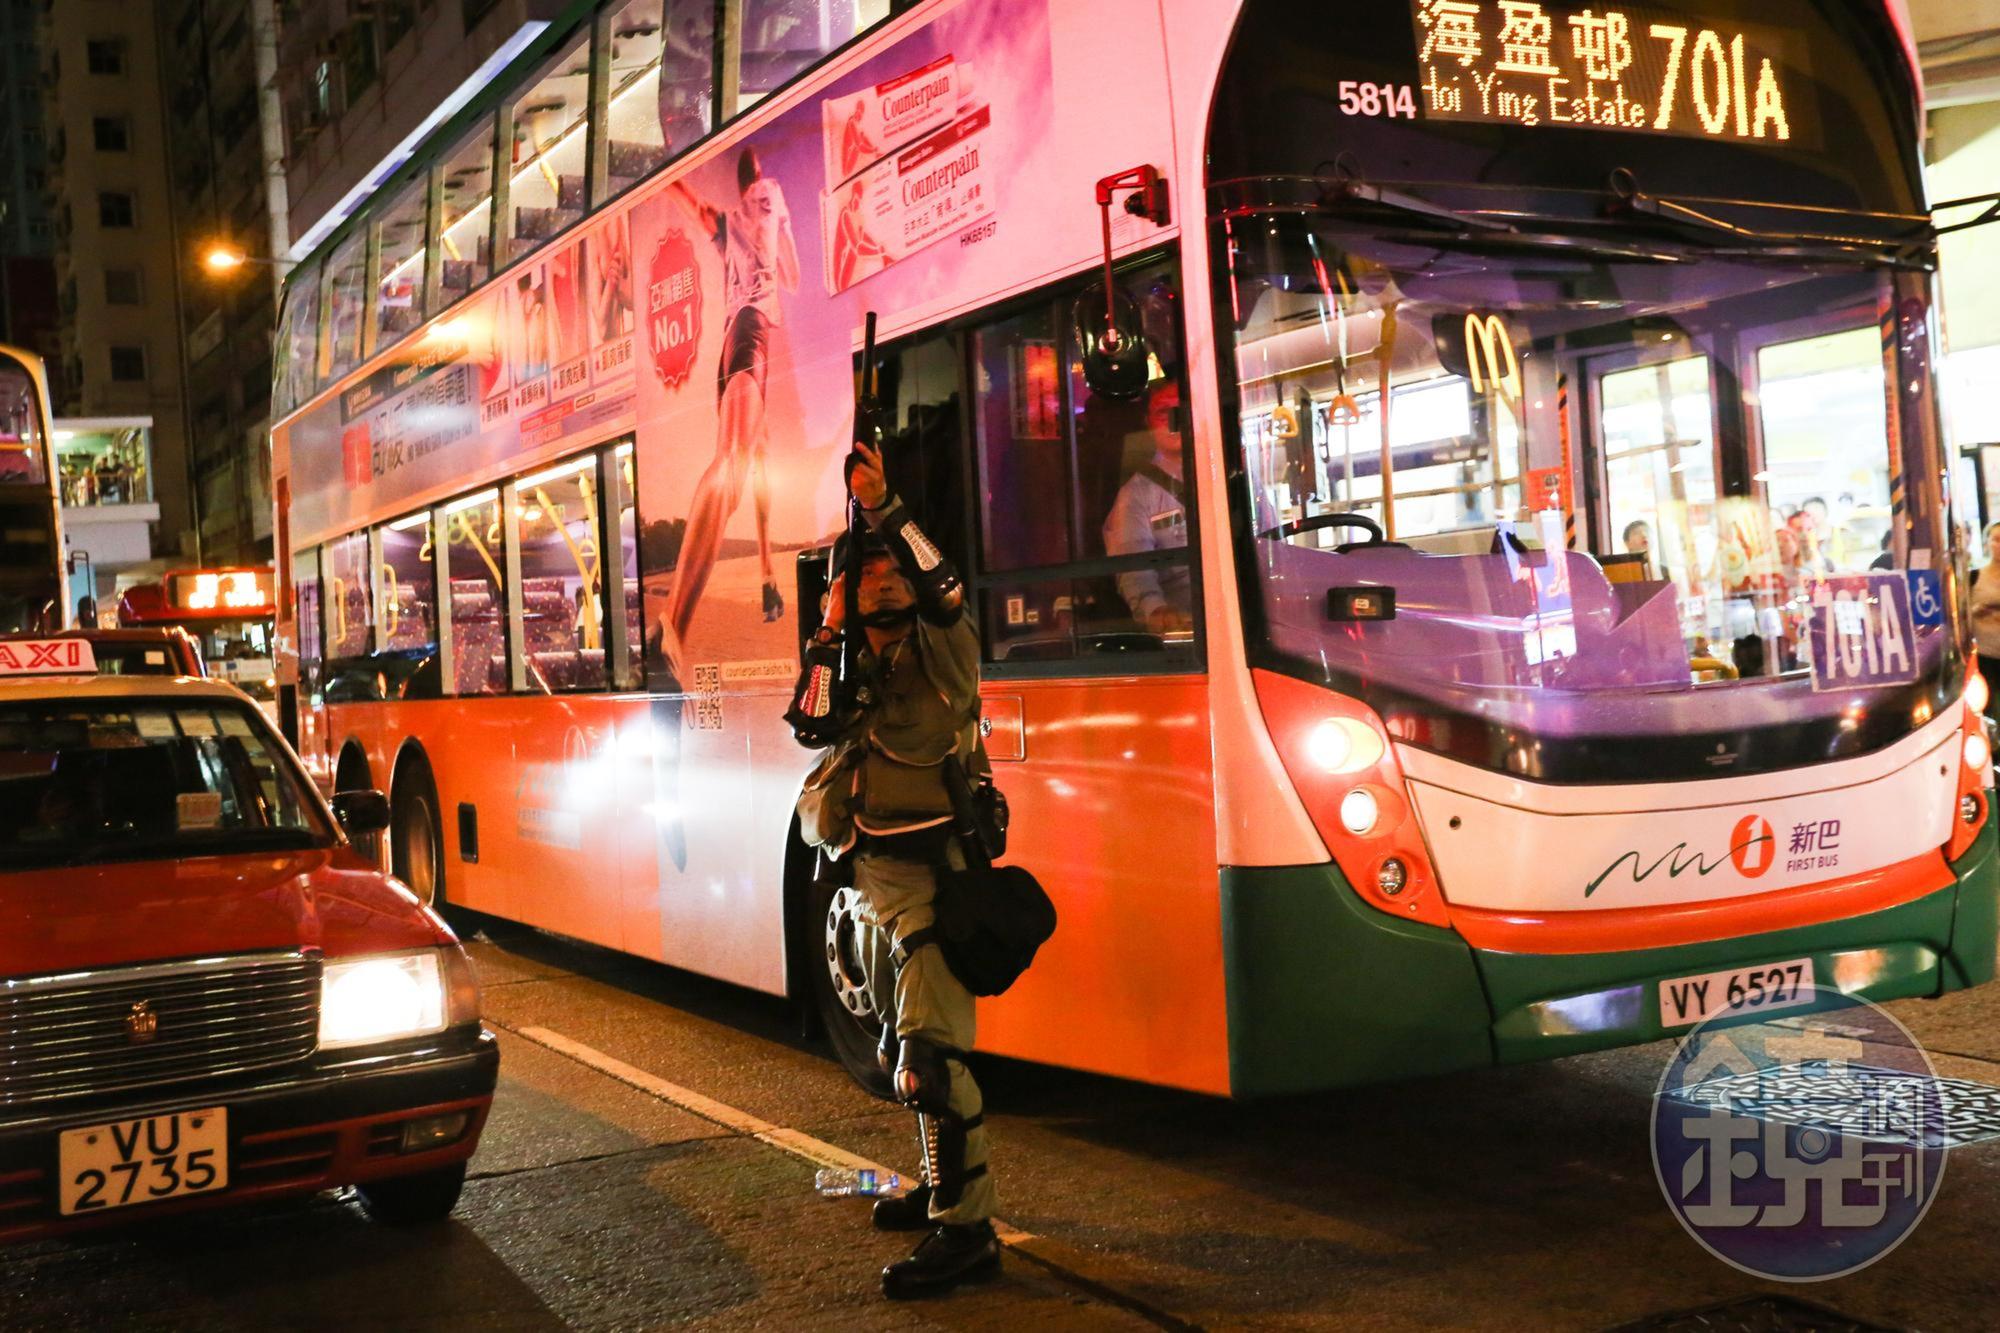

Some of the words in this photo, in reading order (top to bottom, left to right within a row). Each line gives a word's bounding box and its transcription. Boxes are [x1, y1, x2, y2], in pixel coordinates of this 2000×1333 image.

[1417, 0, 1632, 81] 海盈邨
[883, 74, 950, 121] Counterpain
[1338, 81, 1416, 120] 5814
[1471, 70, 1540, 126] Ying
[1548, 77, 1646, 128] Estate
[1649, 24, 1790, 140] 701A
[903, 144, 980, 207] Counterpain
[654, 303, 693, 354] No.1
[1811, 584, 1910, 680] 701A
[1786, 856, 1816, 872] FIRST
[1817, 853, 1839, 868] BUS
[1788, 819, 1841, 855] 新巴
[1670, 980, 1710, 1019] VY
[1727, 965, 1804, 1009] 6527
[110, 1115, 180, 1162] VU
[73, 1148, 217, 1211] 2735
